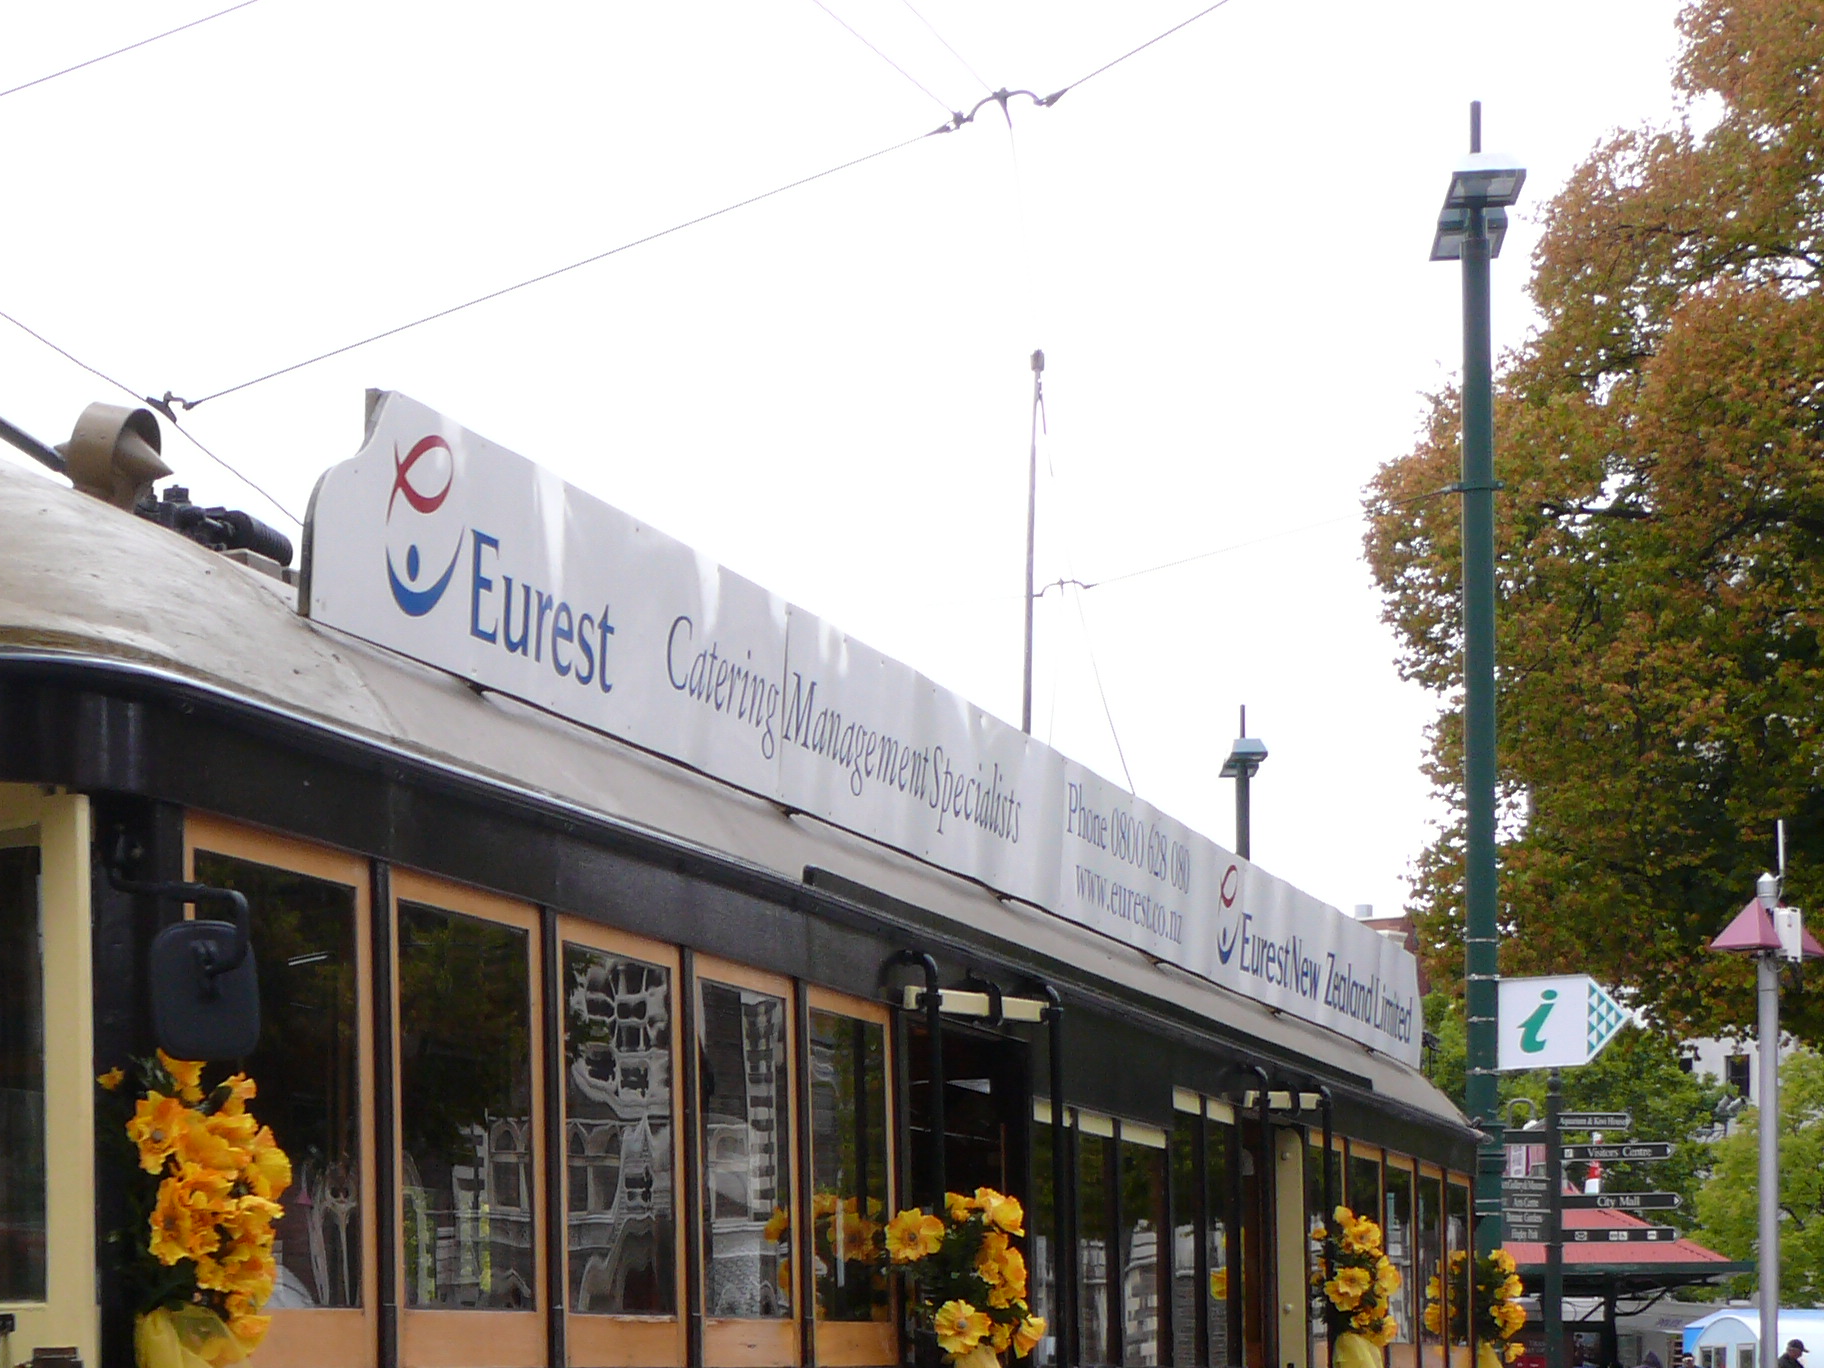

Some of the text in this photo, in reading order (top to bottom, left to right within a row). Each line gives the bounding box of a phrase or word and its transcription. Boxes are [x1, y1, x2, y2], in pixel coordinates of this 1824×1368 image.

[469, 527, 616, 694] Eurest
[666, 615, 1022, 844] Catering Management Specialists
[1066, 782, 1190, 895] Phone 0800 628 080
[1075, 864, 1183, 945] www.eurest.co.nz
[1239, 911, 1413, 1044] Eurest New Zealand Limited
[1587, 1146, 1653, 1158] Visitors Centre
[1596, 1196, 1641, 1209] City Mall
